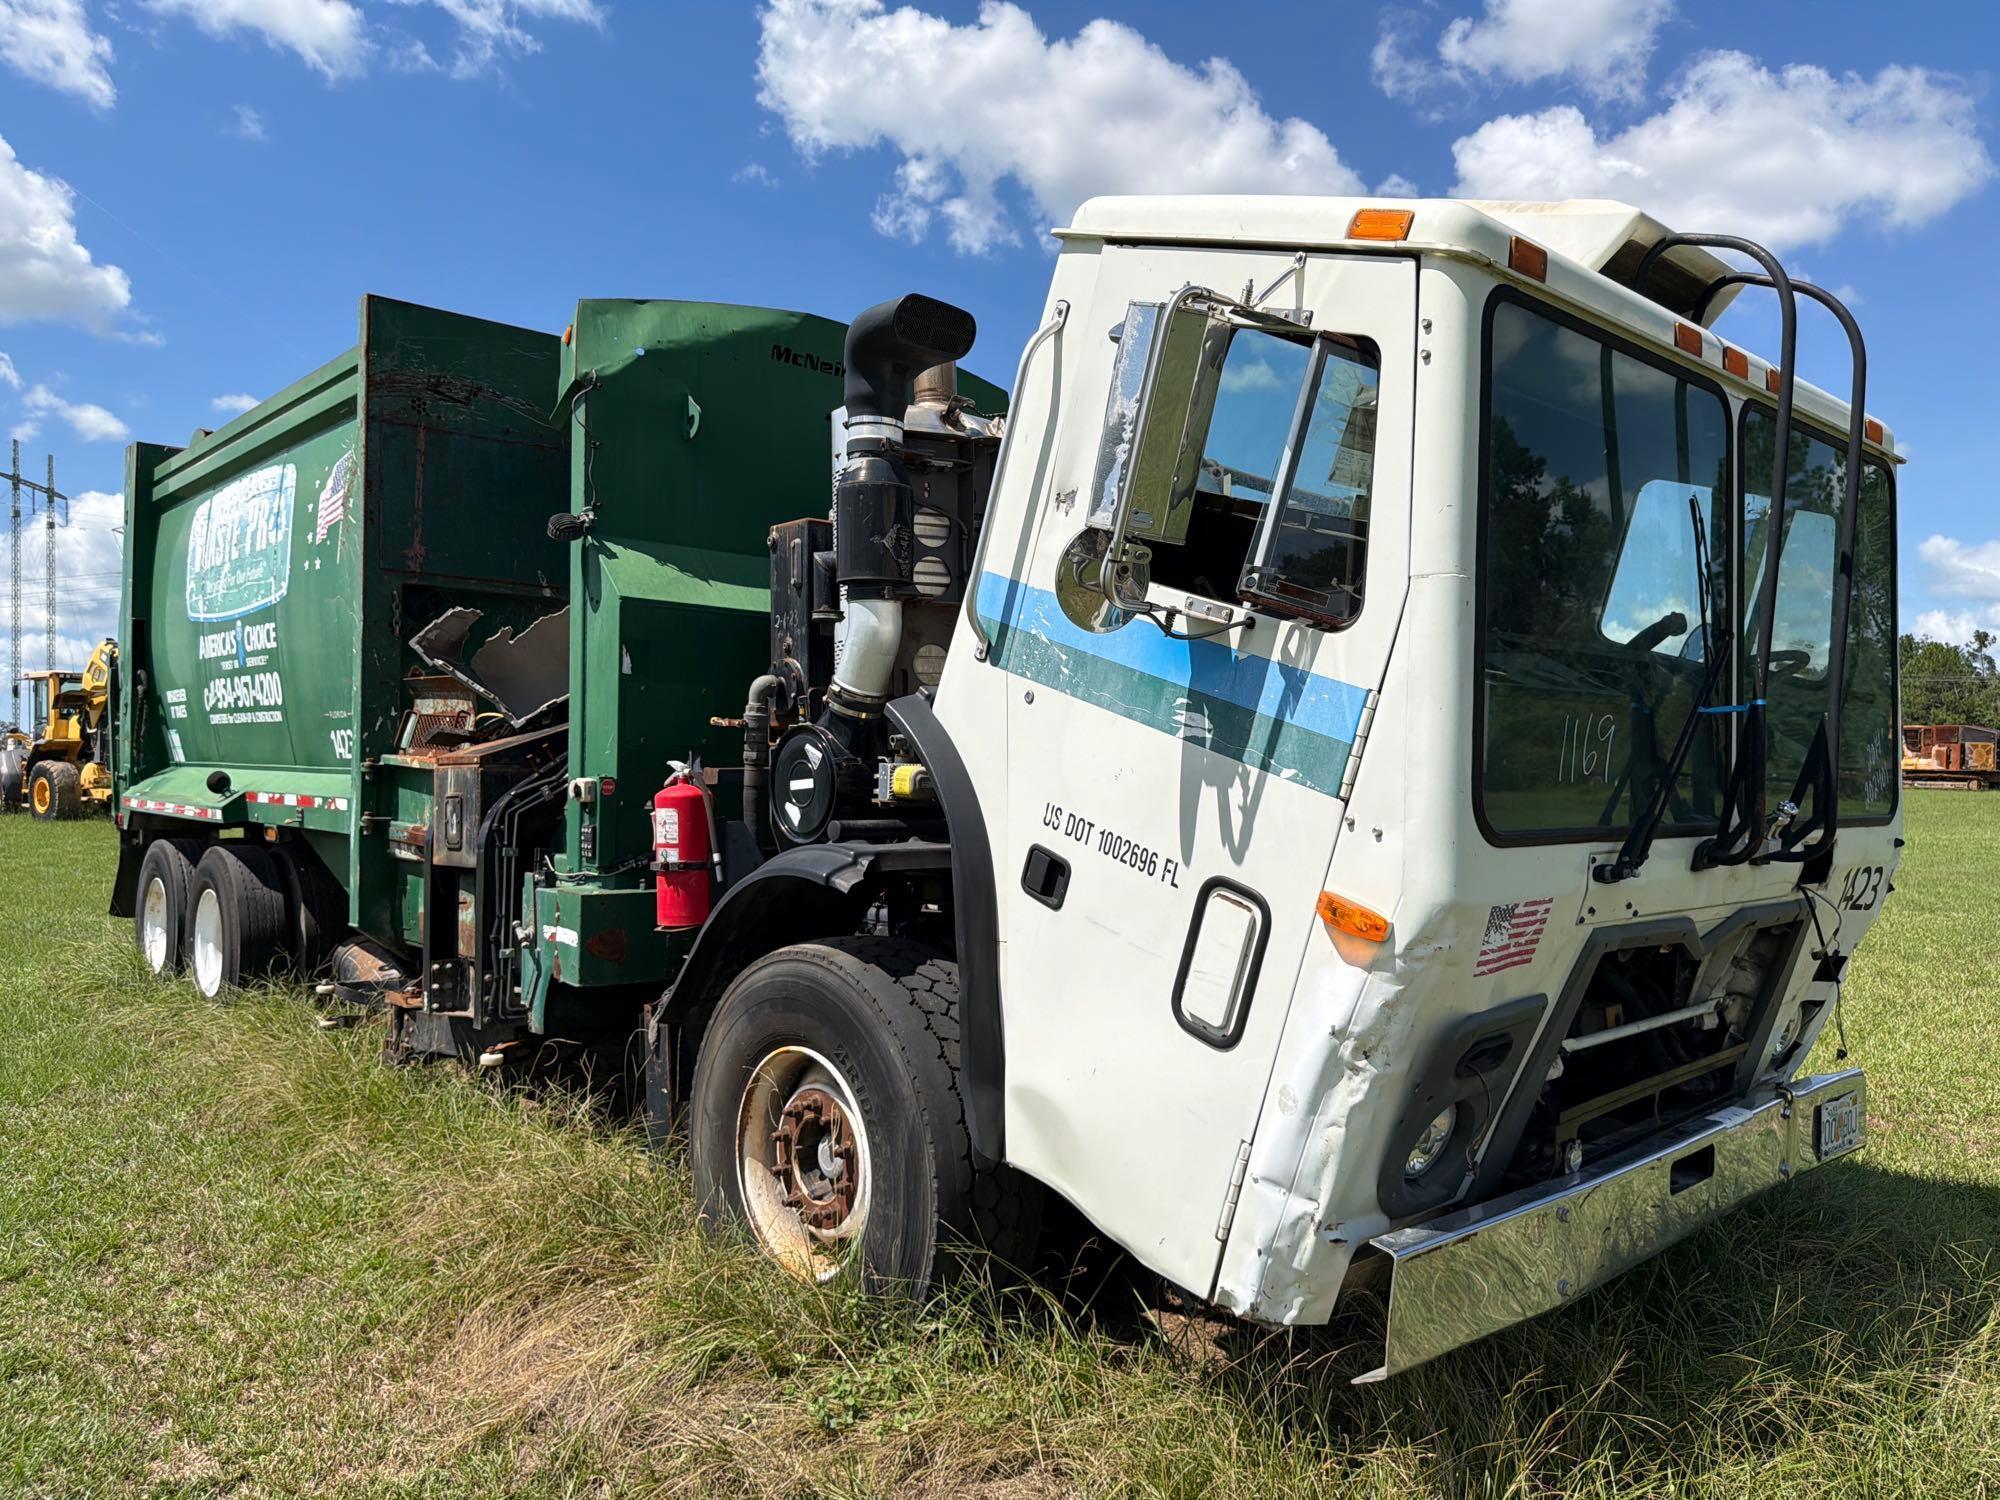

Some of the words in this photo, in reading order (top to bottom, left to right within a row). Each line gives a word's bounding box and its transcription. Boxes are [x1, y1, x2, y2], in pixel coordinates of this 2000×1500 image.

[199, 628, 237, 659] AMERICA'S
[244, 622, 277, 652] CHOICE
[330, 729, 353, 759] 1423
[1559, 712, 1615, 783] 1169
[1043, 802, 1063, 831] US
[1064, 812, 1095, 846] DOT
[1098, 829, 1159, 878] 1002696
[1160, 858, 1179, 889] FL
[1837, 865, 1884, 911] 1423
